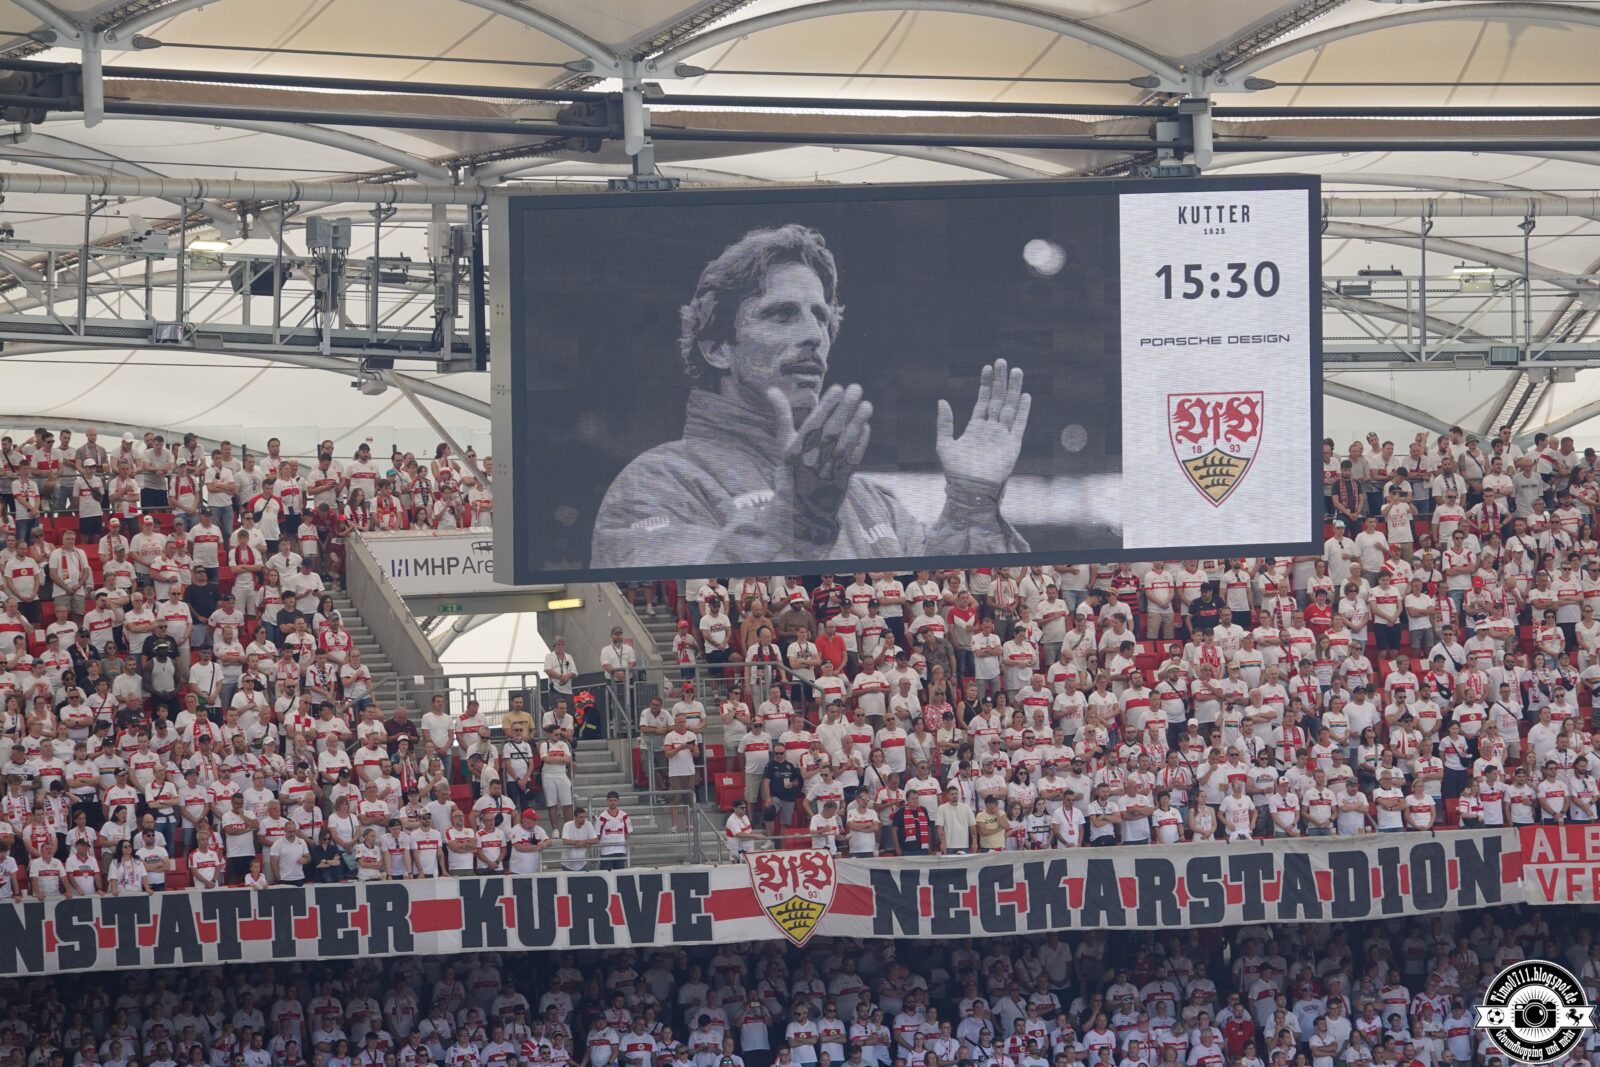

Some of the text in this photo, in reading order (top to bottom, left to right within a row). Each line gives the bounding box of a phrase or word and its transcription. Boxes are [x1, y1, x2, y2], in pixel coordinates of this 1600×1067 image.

[1178, 204, 1250, 224] KUTTER
[1155, 260, 1280, 299] 15:30
[1140, 334, 1290, 347] PORSCHE DESIGN
[1192, 444, 1241, 454] 18 93
[413, 557, 460, 576] MHP
[870, 835, 1503, 936] NECKARSTADION
[774, 891, 818, 901] 18 93
[459, 872, 713, 948] KURVE
